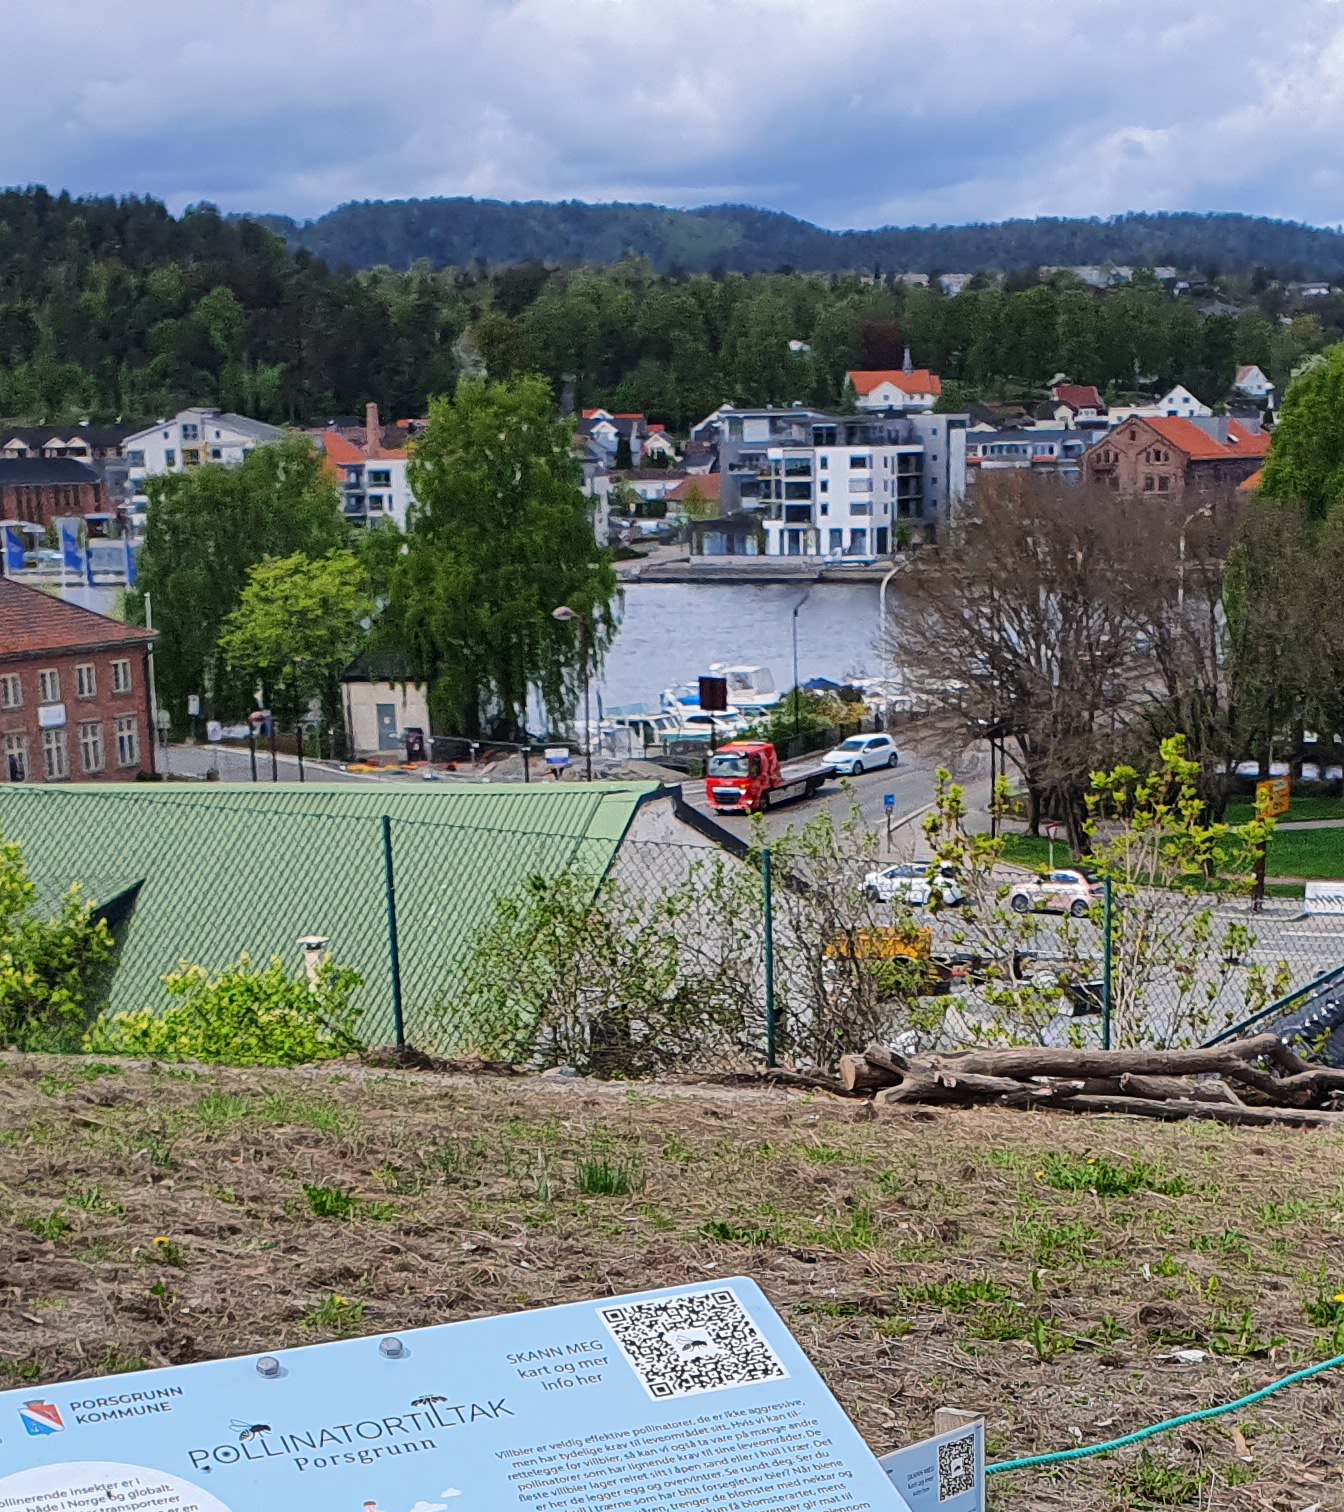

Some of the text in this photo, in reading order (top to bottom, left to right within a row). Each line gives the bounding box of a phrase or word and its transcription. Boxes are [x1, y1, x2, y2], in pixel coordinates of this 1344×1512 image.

[506, 1339, 603, 1364] SKANN MEG
[516, 1356, 608, 1378] kart og mer
[574, 1373, 602, 1385] her
[69, 1386, 183, 1412] PORSGRUNN
[75, 1401, 172, 1424] KOMMUNE
[187, 1398, 515, 1469] POLLINATORTILTAK
[292, 1439, 437, 1471] Porsgrunn
[66, 1496, 106, 1508] Norge
[182, 1504, 198, 1512] en
